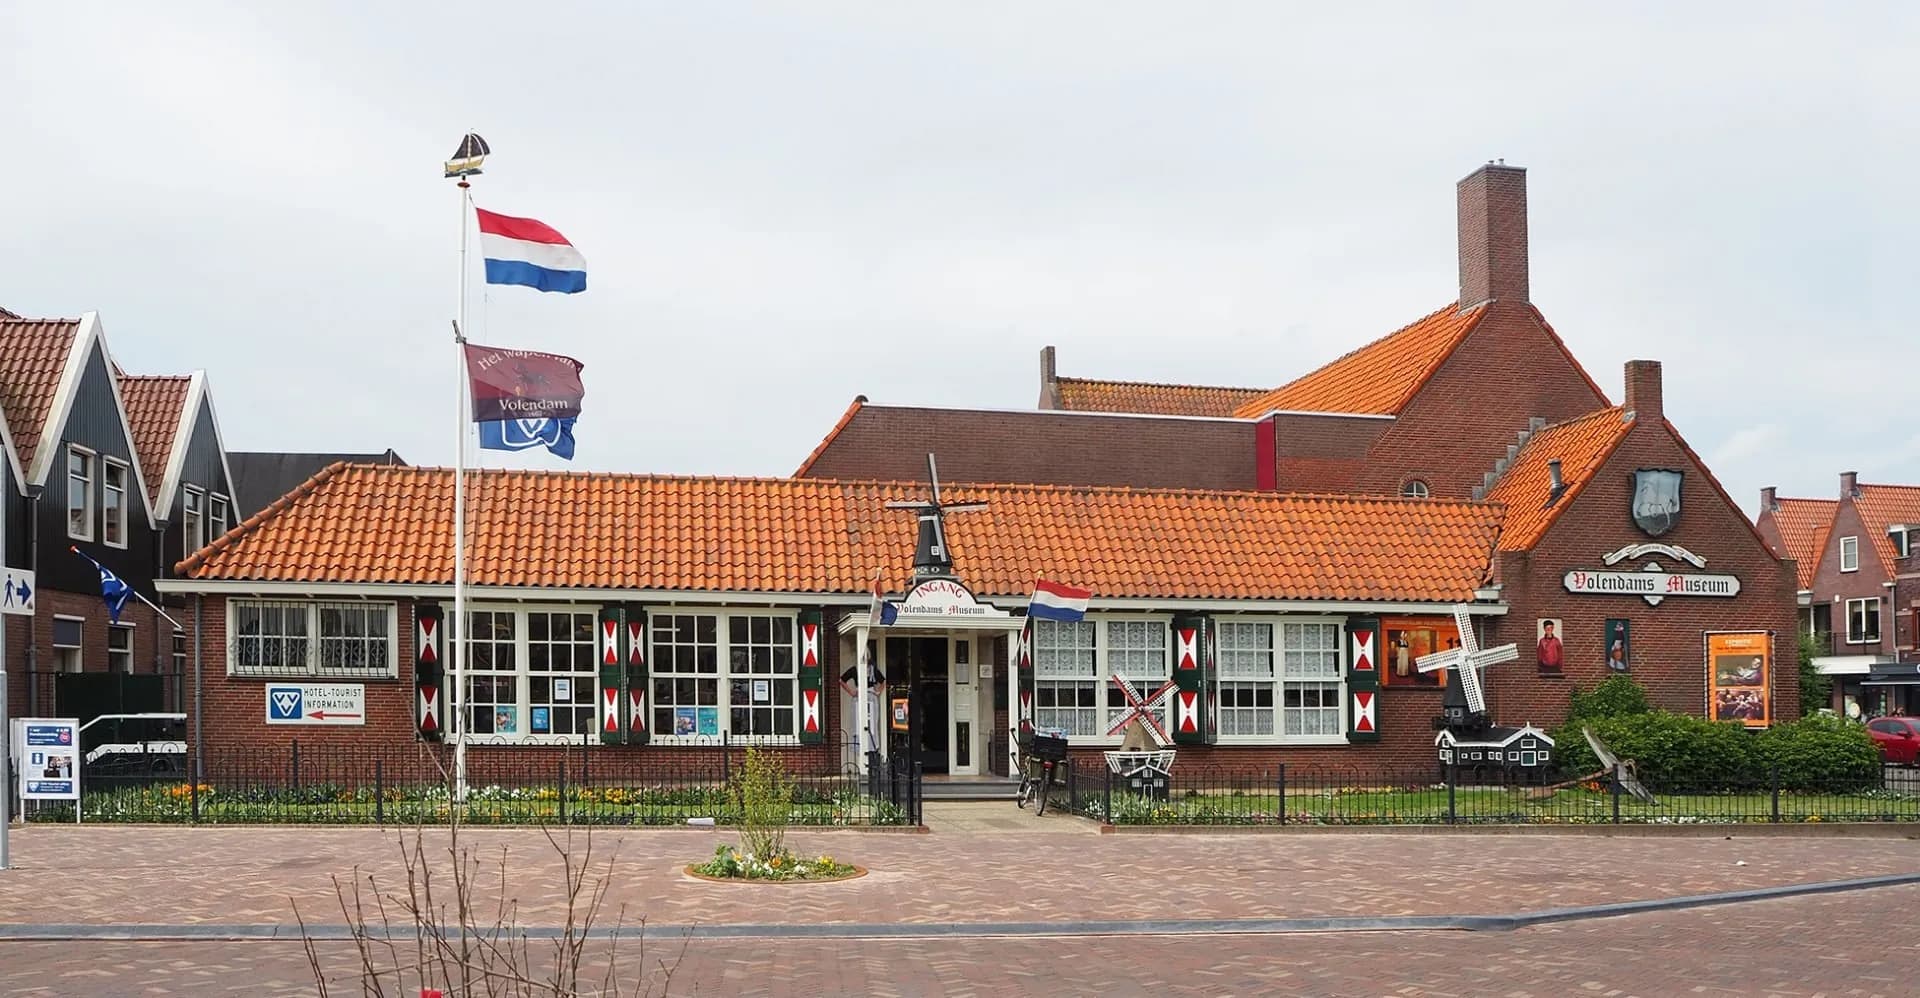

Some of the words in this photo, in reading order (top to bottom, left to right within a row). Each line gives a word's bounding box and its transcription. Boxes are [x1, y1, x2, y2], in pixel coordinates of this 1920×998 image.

[478, 352, 502, 370] Het
[499, 399, 568, 411] Volendam
[1572, 572, 1655, 591] Volendams
[1666, 575, 1729, 593] Museum
[915, 582, 966, 598] INGANG
[896, 604, 943, 615] Volendams
[948, 605, 985, 615] Museum
[304, 688, 361, 697] HOTEL-TOURIST
[304, 700, 354, 709] INFORMATION
